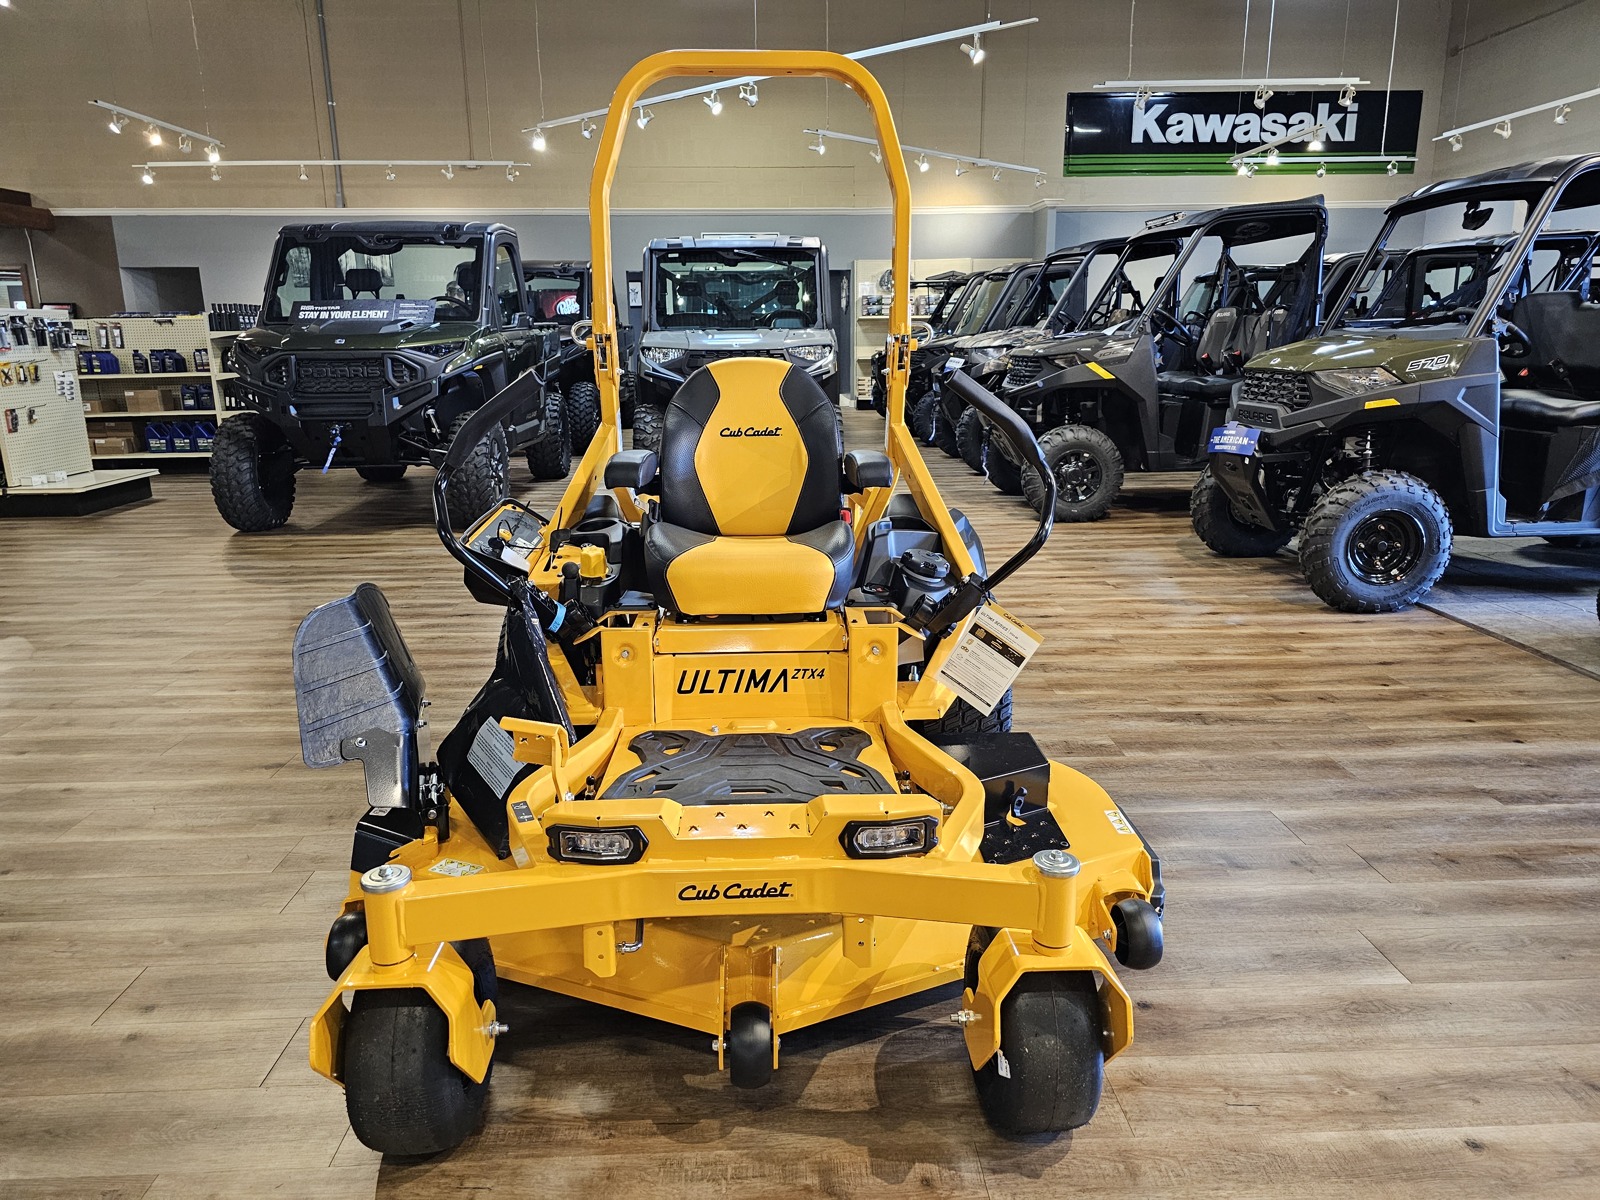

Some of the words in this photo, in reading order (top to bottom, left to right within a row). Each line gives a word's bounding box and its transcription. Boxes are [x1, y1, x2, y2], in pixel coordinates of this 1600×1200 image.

[1131, 102, 1359, 144] Kawasaki
[298, 311, 319, 319] STAY
[319, 311, 330, 319] IN
[330, 311, 352, 319] YOUR
[352, 310, 389, 319] ELEMENT
[1405, 353, 1450, 372] 570
[301, 367, 381, 378] POLARIS
[1238, 409, 1273, 424] POLARIS
[720, 427, 743, 437] Cub
[744, 427, 782, 437] Cadet
[1220, 436, 1249, 446] AMERICAN
[676, 668, 788, 695] ULTIMA
[791, 668, 826, 680] ZTX4
[677, 884, 721, 901] Cub
[723, 881, 793, 900] Cadet
